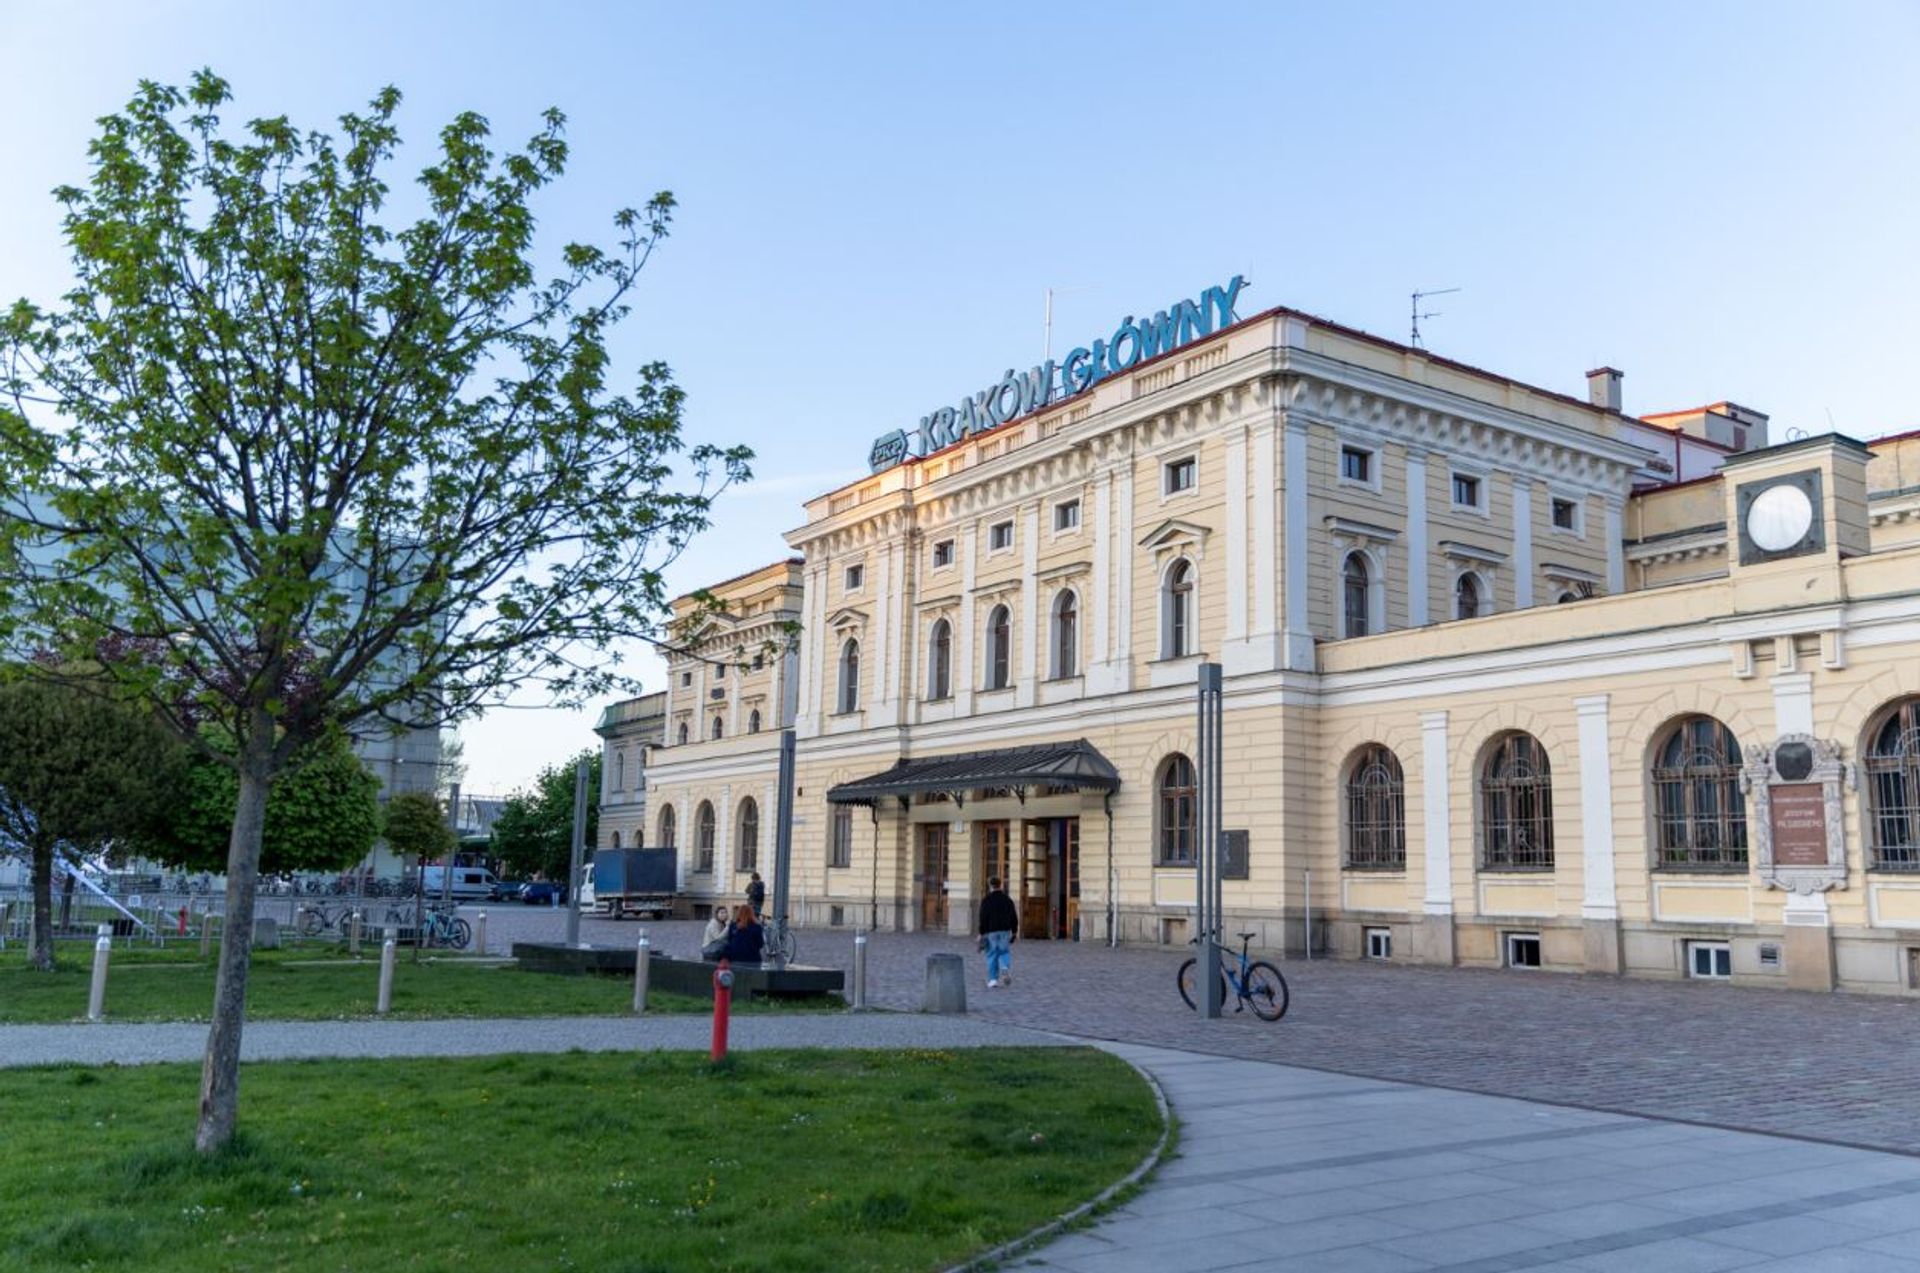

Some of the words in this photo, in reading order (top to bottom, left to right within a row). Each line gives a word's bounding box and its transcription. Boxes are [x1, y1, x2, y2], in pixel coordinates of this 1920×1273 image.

[919, 359, 1055, 456] KRAKÓW
[1062, 275, 1244, 395] GŁÓWNY
[875, 440, 902, 464] PKP
